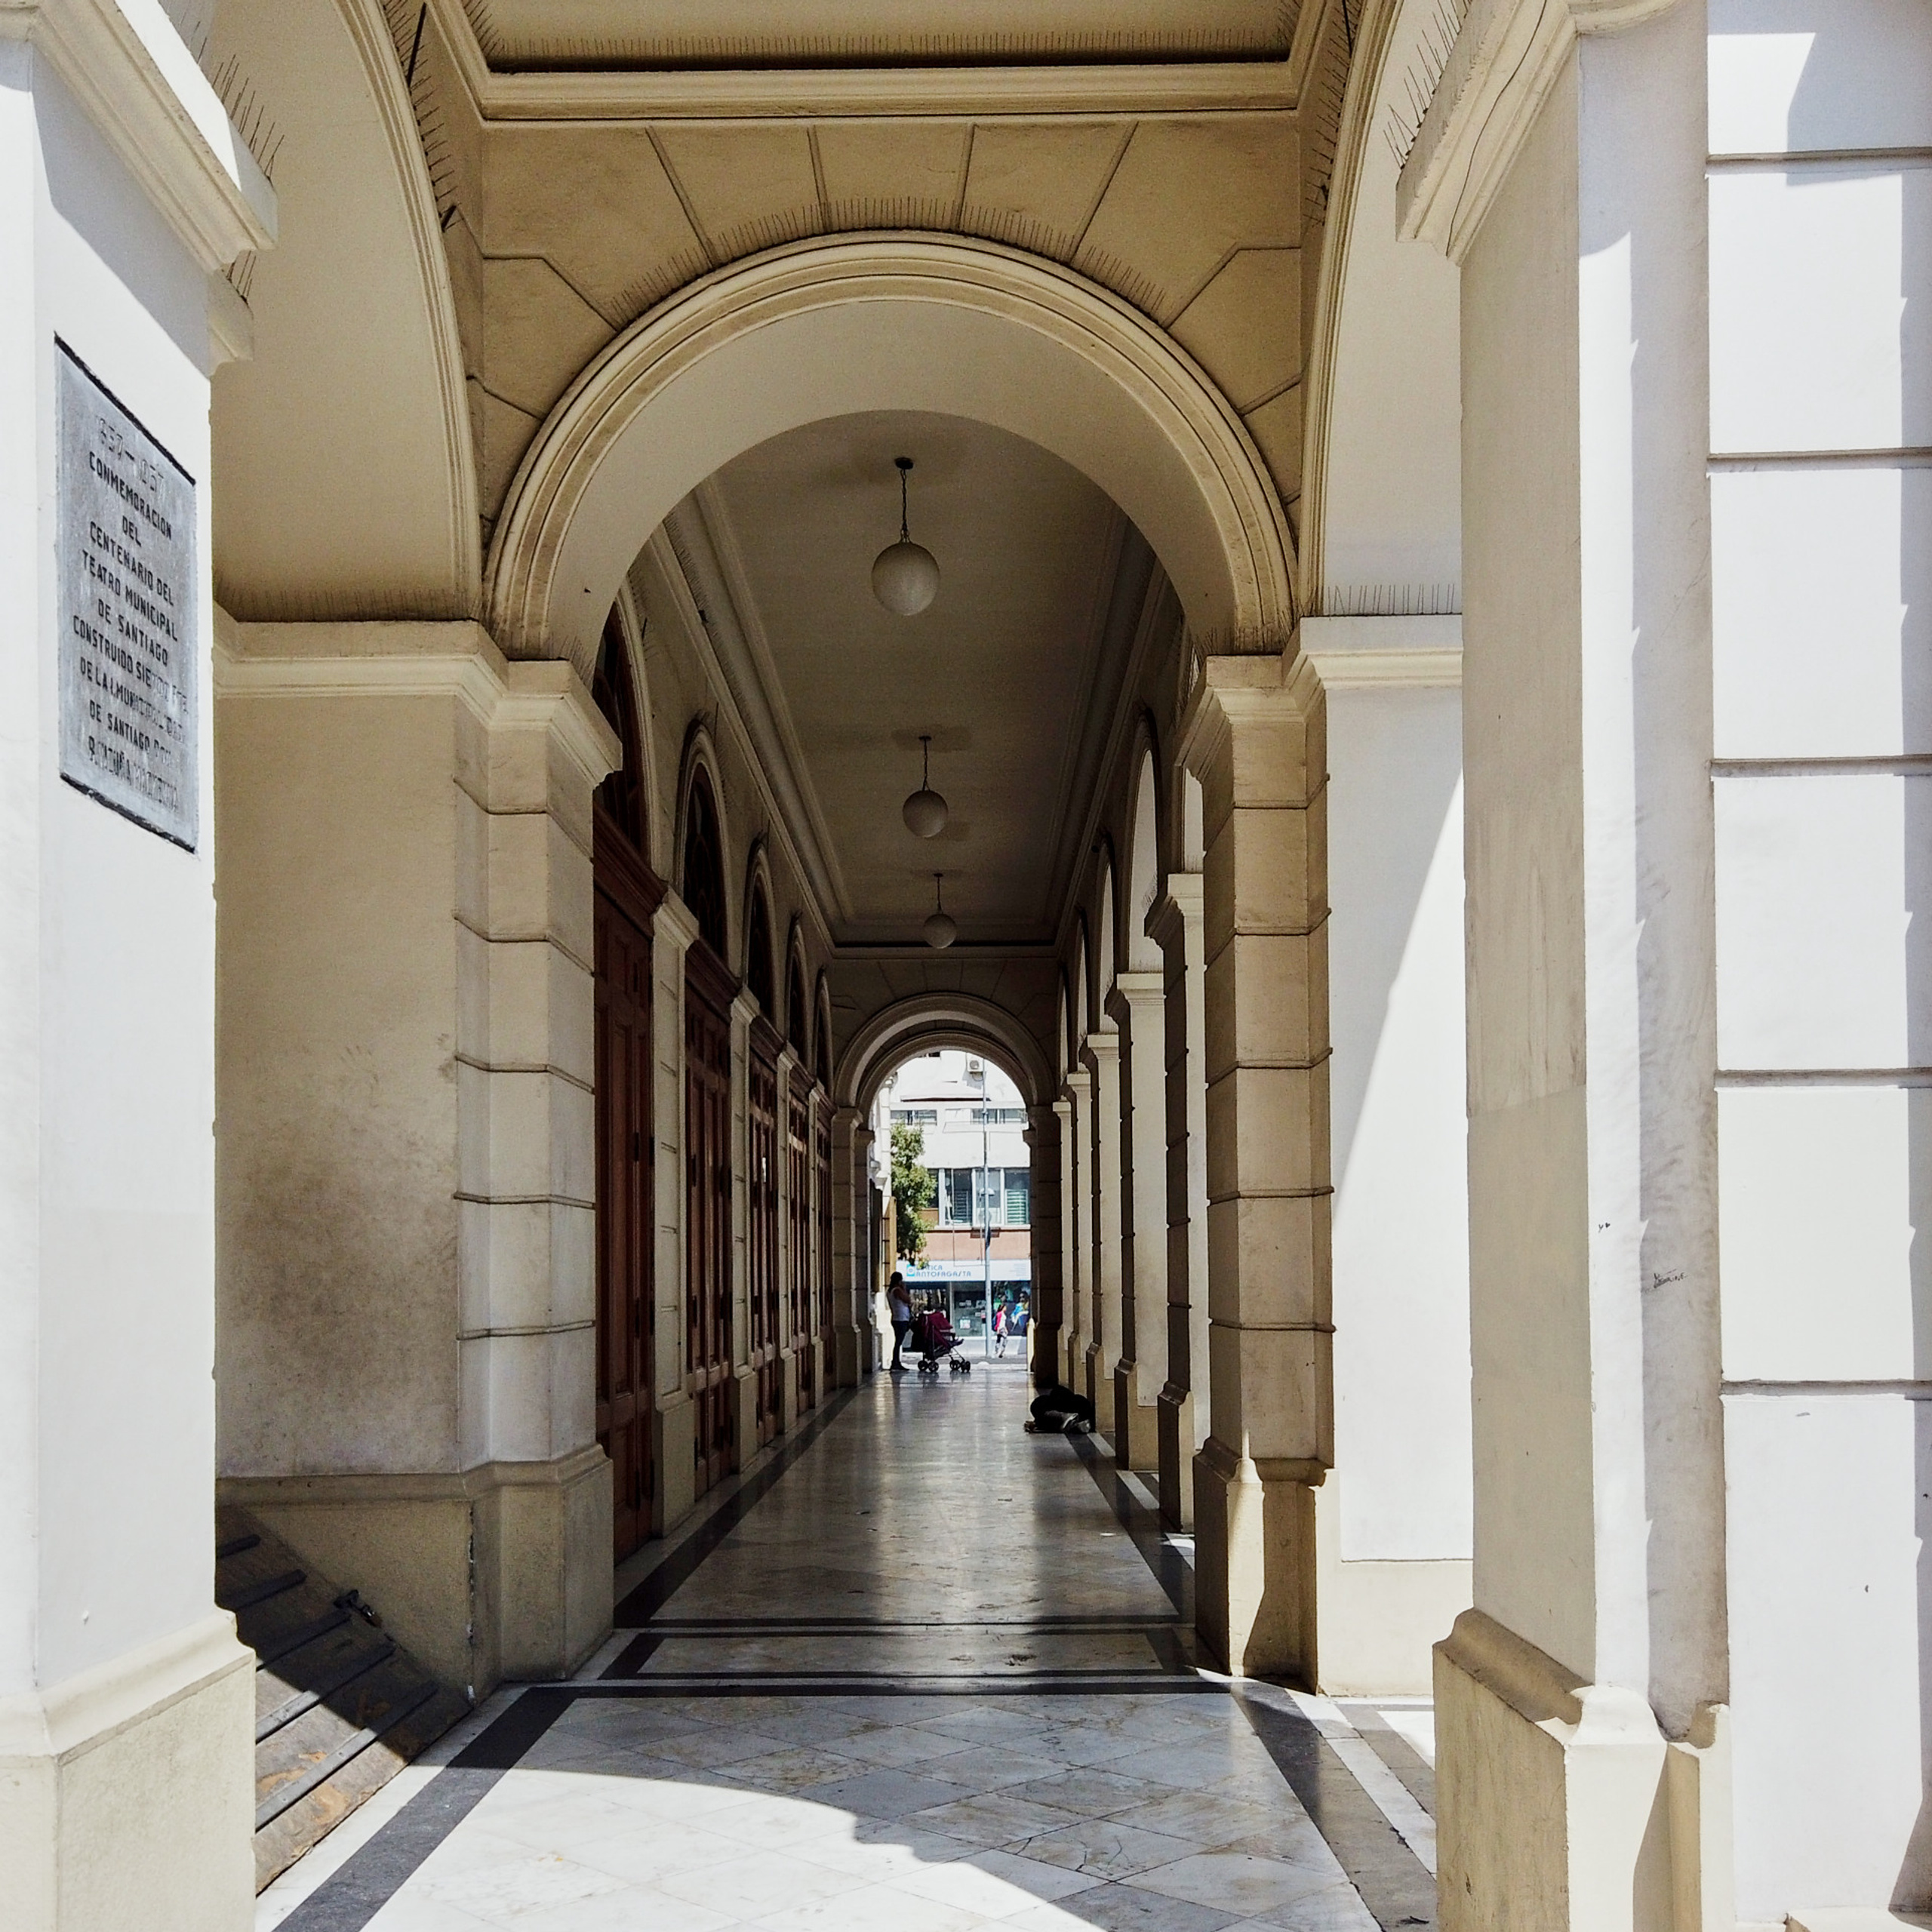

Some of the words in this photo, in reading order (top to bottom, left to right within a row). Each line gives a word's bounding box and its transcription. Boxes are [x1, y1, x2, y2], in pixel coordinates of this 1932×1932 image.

[89, 451, 171, 540] CONMEMORACION
[122, 515, 141, 546] DEL
[90, 521, 152, 589] CENTENARIO
[156, 577, 173, 606] DEL
[82, 551, 121, 595] TEATRO
[125, 586, 177, 641] MUNICIPAL
[73, 615, 133, 673] CONSTRUIDO
[98, 598, 110, 623] DE
[118, 614, 168, 666] SANTIAGO
[80, 656, 92, 681] DE
[95, 666, 107, 691] LA
[89, 699, 101, 723] DE
[107, 712, 149, 752] SANTIAGO
